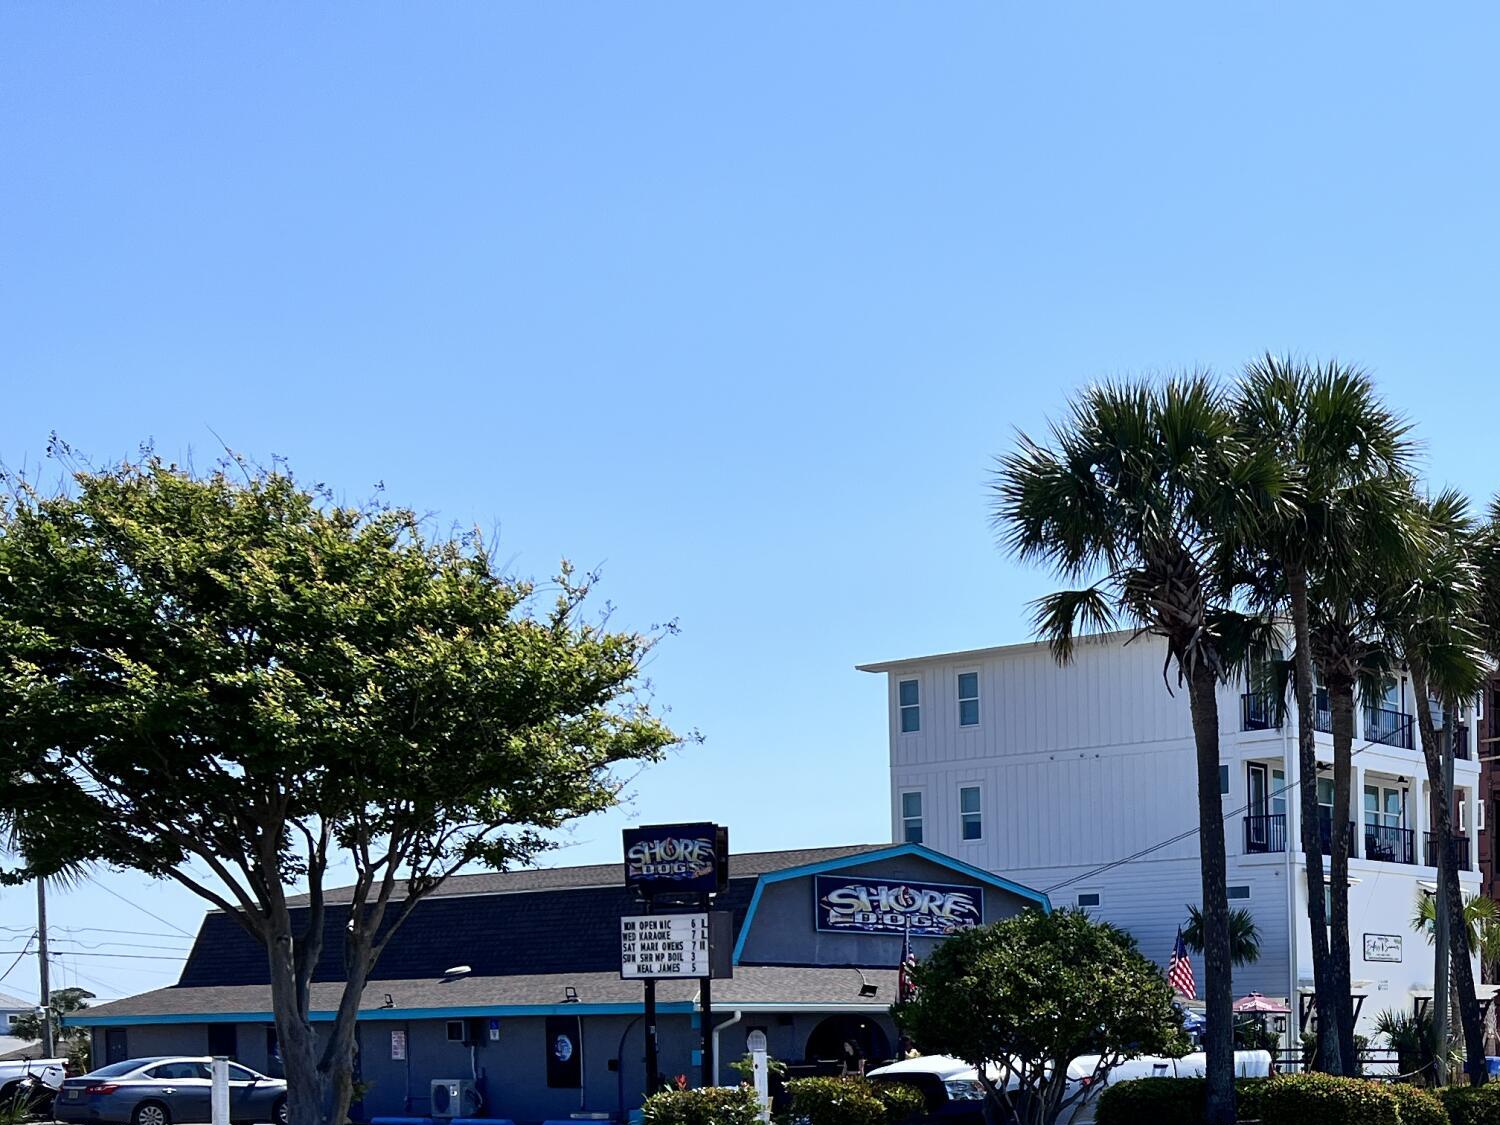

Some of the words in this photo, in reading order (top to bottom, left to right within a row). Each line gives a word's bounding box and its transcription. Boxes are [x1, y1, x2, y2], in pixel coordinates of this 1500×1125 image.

[627, 838, 712, 866] SHORE
[641, 861, 699, 876] DOGS
[827, 885, 974, 921] SHORE
[639, 920, 658, 930] OPEN
[691, 919, 696, 928] 6
[854, 910, 955, 929] DOGS
[622, 932, 636, 942] WED
[639, 931, 671, 941] KARAOKE
[691, 930, 696, 939] 7
[622, 942, 636, 952] SAT
[691, 941, 697, 950] 7
[622, 953, 636, 963] SUN
[667, 952, 684, 962] BOIL
[691, 952, 696, 961] 3
[637, 963, 654, 973] NEAL
[657, 963, 681, 973] JAMES
[691, 963, 697, 973] 5
